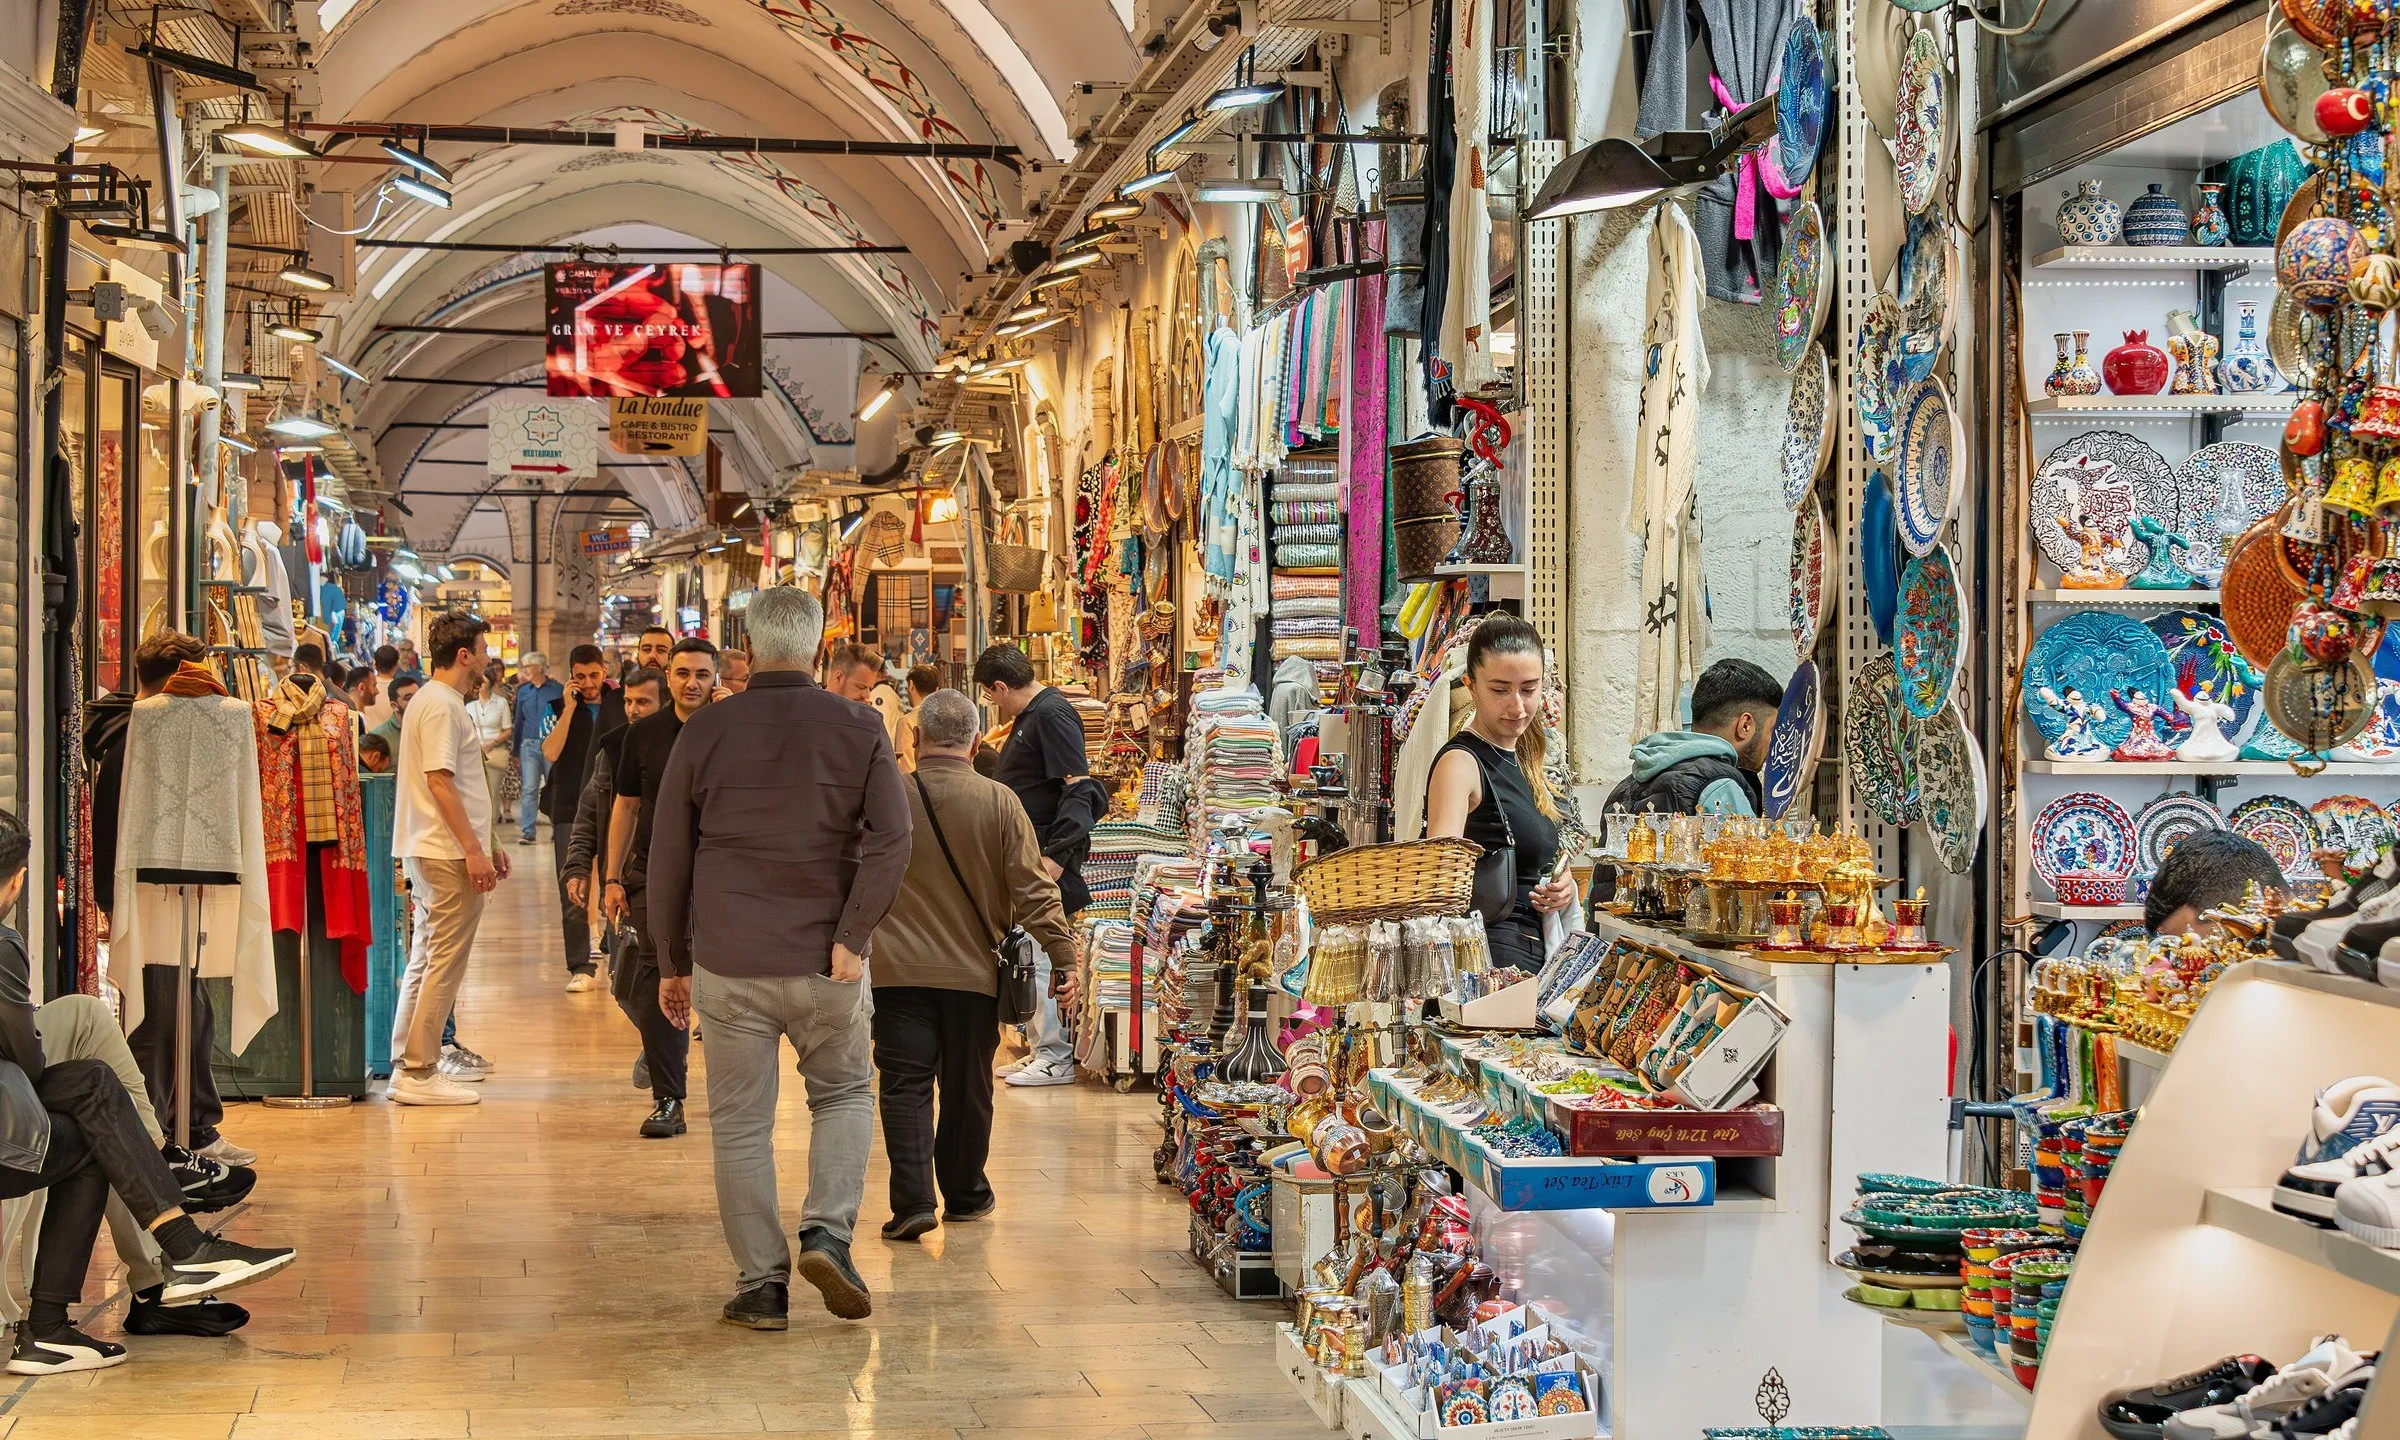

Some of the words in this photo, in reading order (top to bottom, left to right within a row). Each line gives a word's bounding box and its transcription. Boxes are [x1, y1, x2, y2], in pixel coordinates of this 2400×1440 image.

[604, 324, 624, 336] VE
[633, 324, 702, 338] ÇEYREK
[617, 397, 638, 415] La
[641, 397, 704, 417] Fondue
[621, 420, 649, 430] CAFE
[650, 422, 658, 430] &
[660, 422, 698, 432] BISTRO
[627, 430, 691, 441] RESTORANT
[590, 532, 610, 542] WC
[1615, 1128, 1642, 1142] Seti
[1543, 1176, 1569, 1190] Set
[1573, 1176, 1600, 1190] Tea
[1600, 1172, 1634, 1189] Lüx
